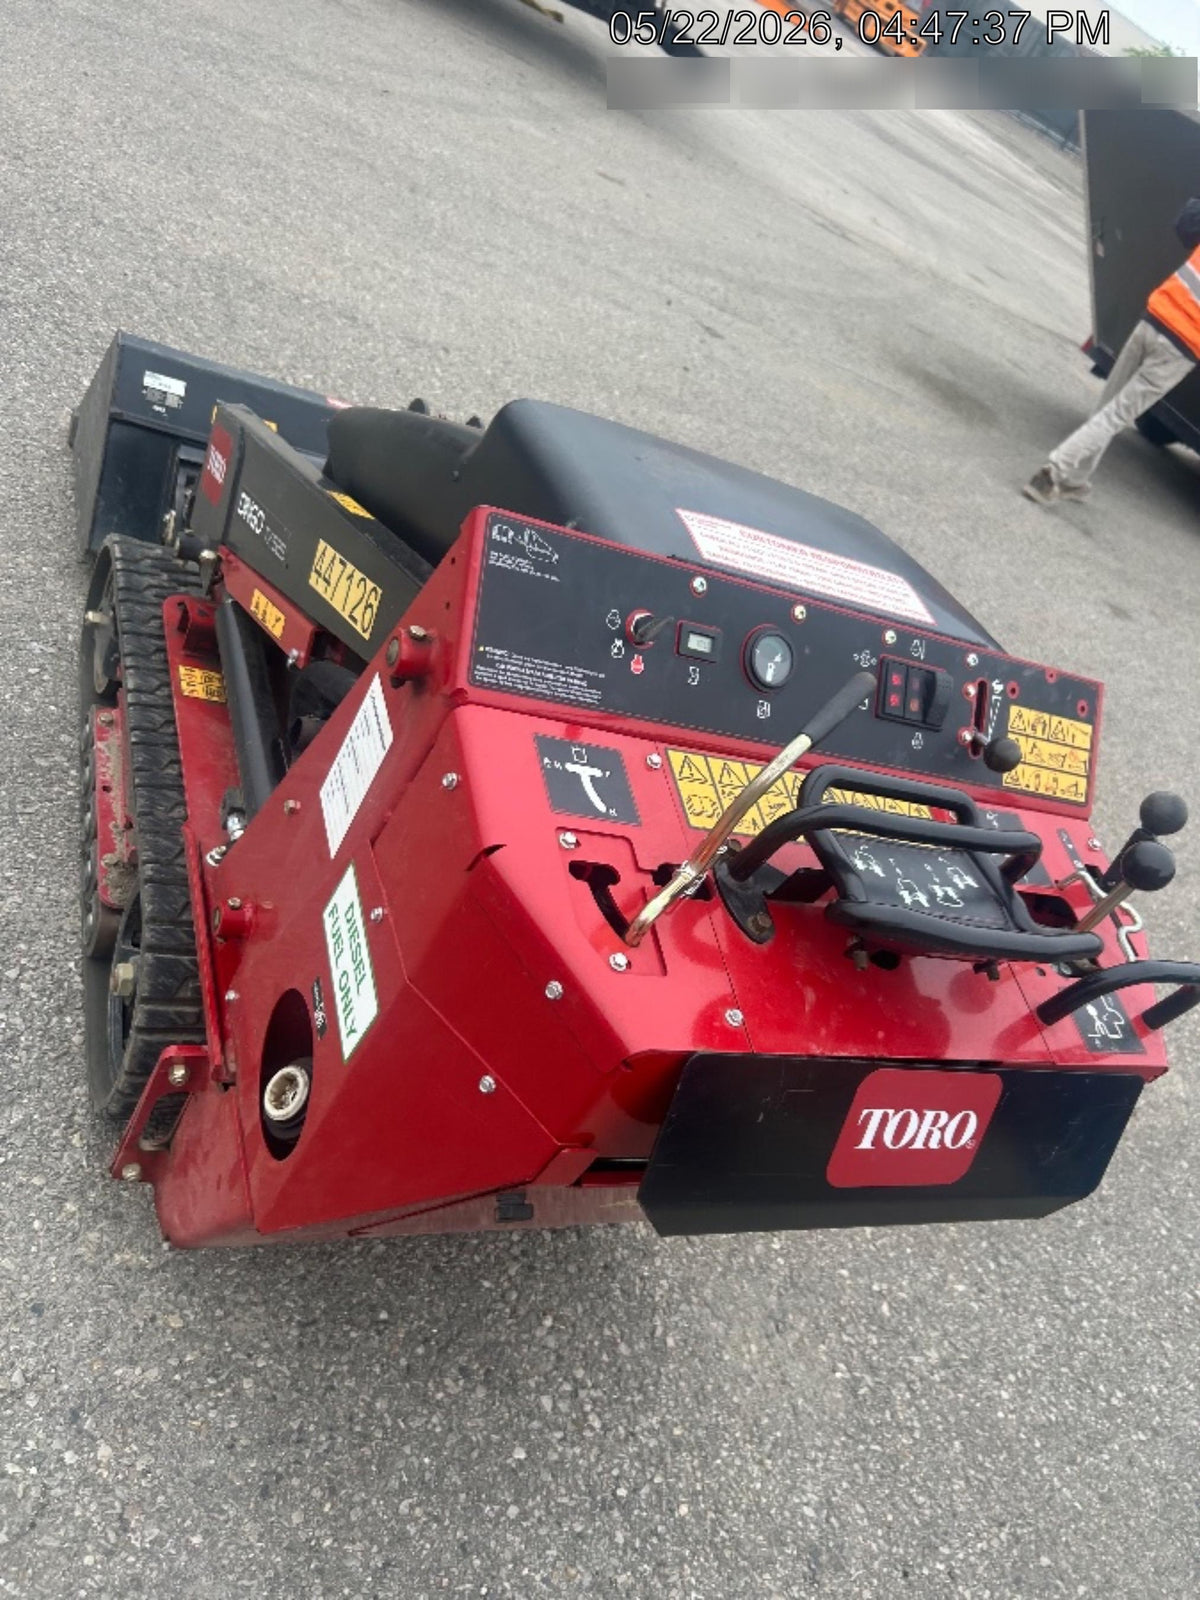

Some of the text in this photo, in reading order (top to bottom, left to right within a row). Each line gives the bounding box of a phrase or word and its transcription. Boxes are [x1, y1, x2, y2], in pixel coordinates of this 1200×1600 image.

[314, 544, 378, 634] 447126
[328, 903, 358, 1039] FUEL ONLY
[343, 900, 367, 995] DIESEL
[853, 1108, 978, 1150] TORO
